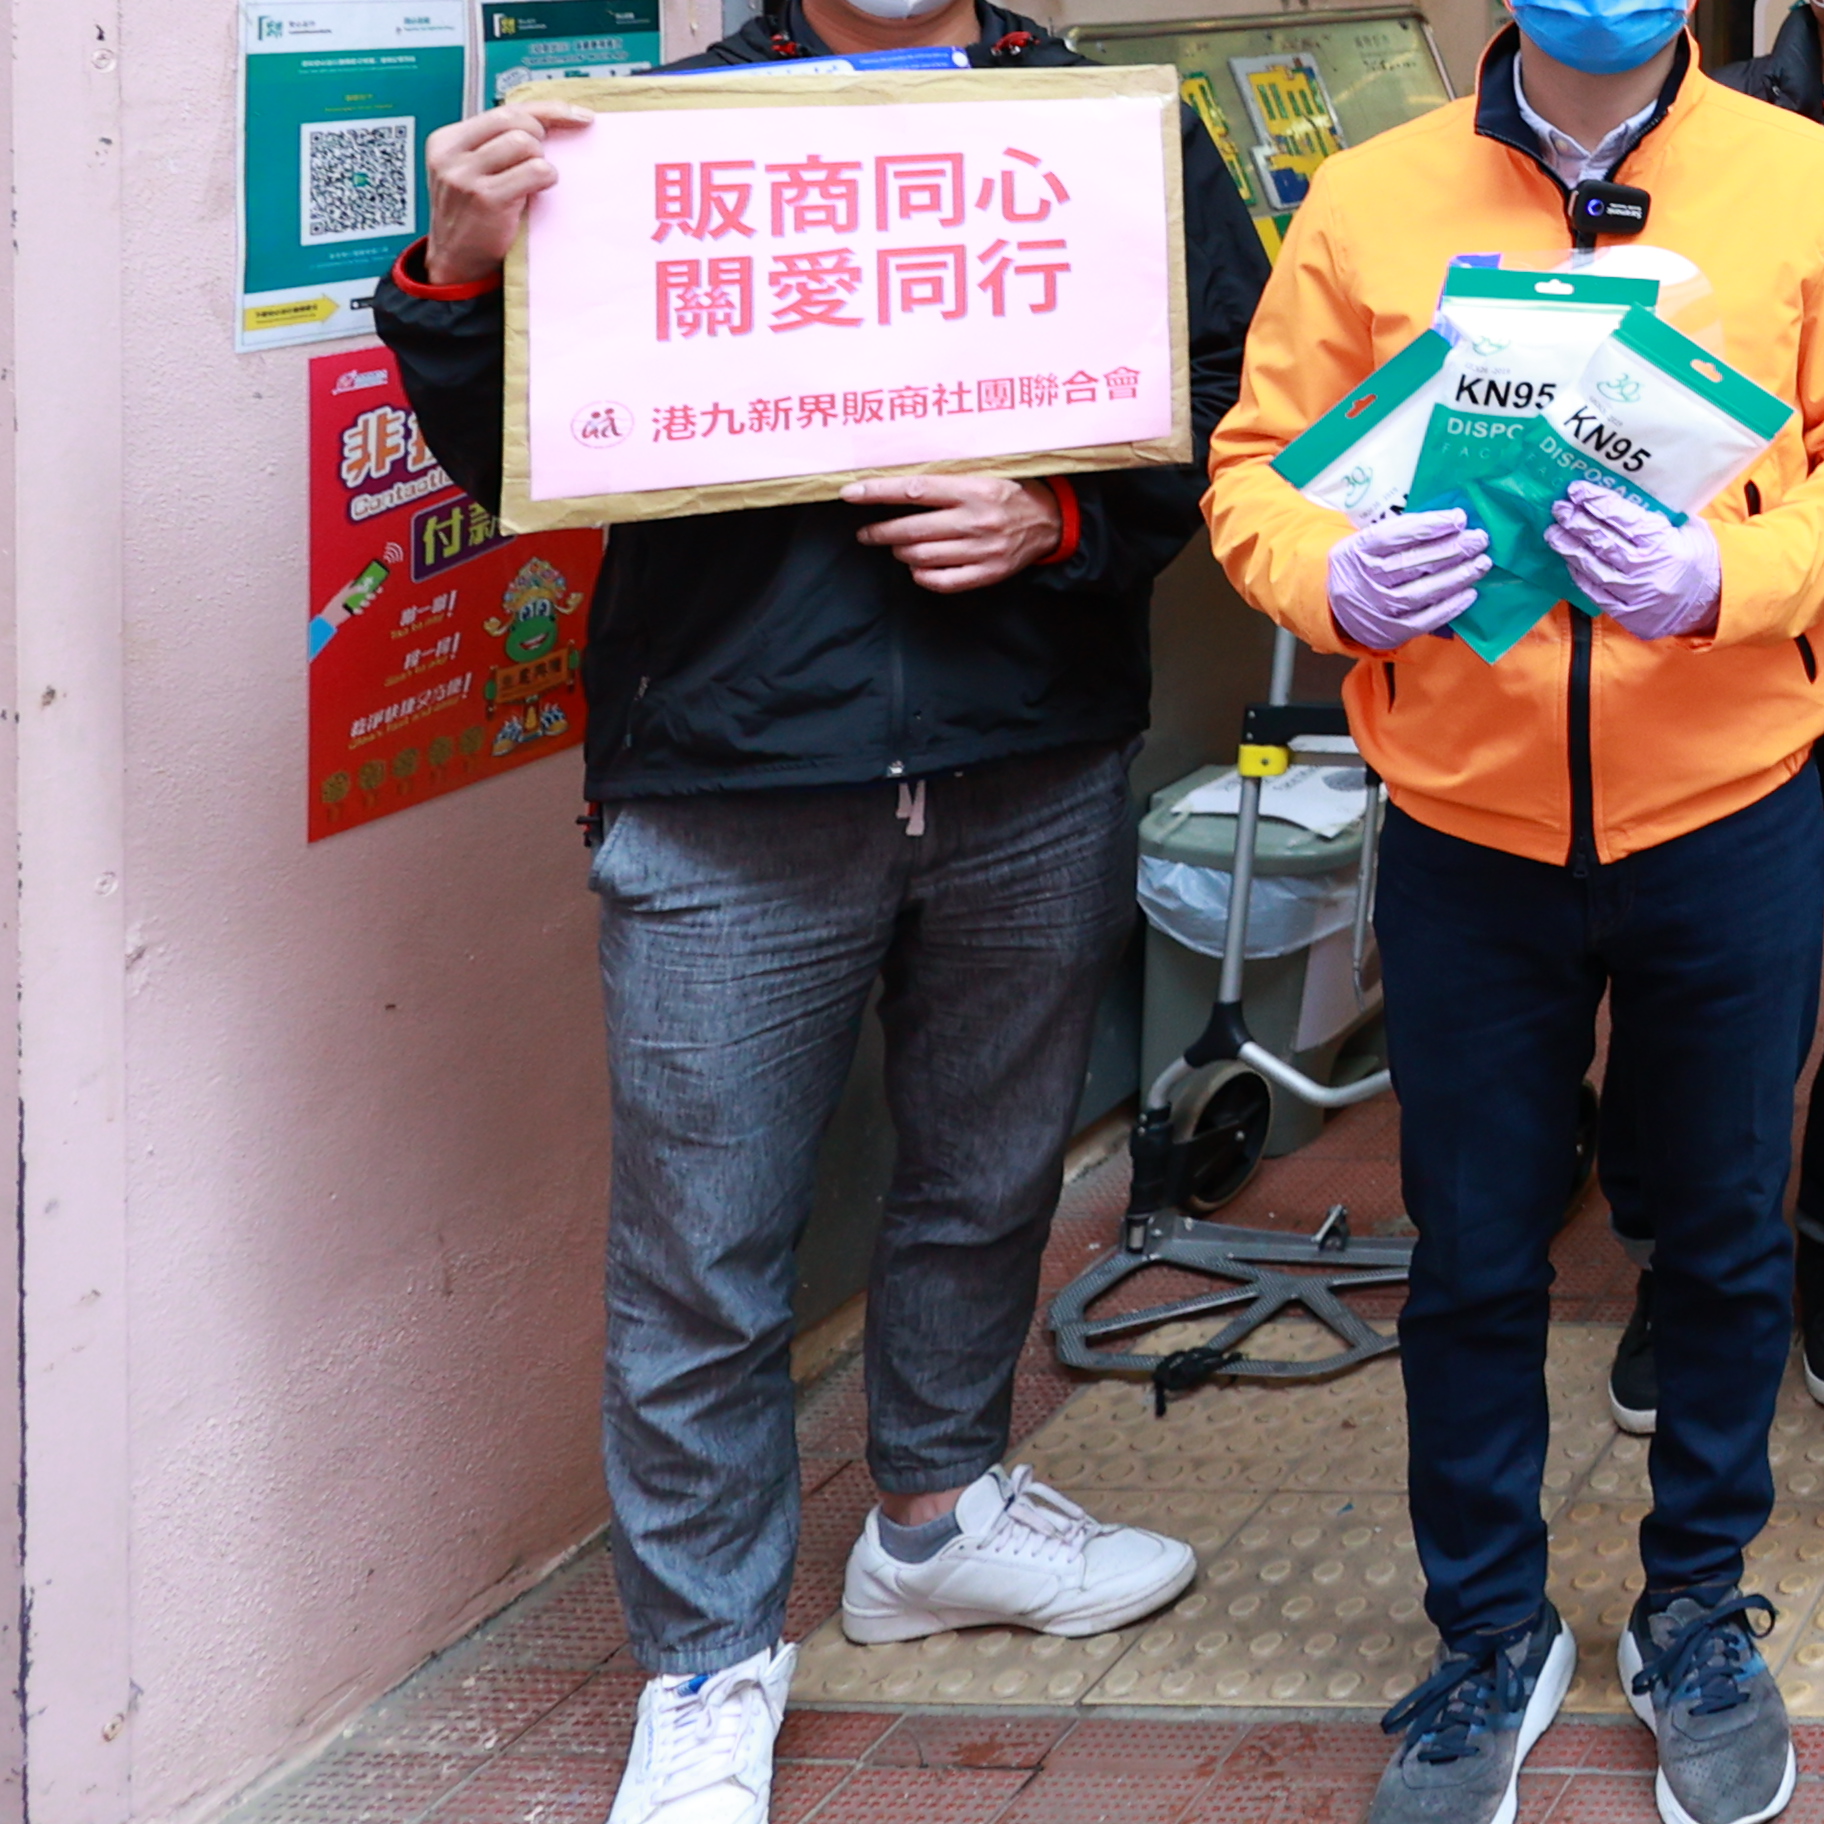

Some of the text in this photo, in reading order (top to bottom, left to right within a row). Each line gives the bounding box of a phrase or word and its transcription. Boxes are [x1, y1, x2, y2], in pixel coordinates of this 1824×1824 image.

[650, 146, 1071, 243] 販商同心
[653, 237, 1072, 342] 關愛同行
[650, 366, 1142, 443] 港九新界販商社團聯合會
[1455, 373, 1557, 416] KN95
[1564, 405, 1652, 475] KN95
